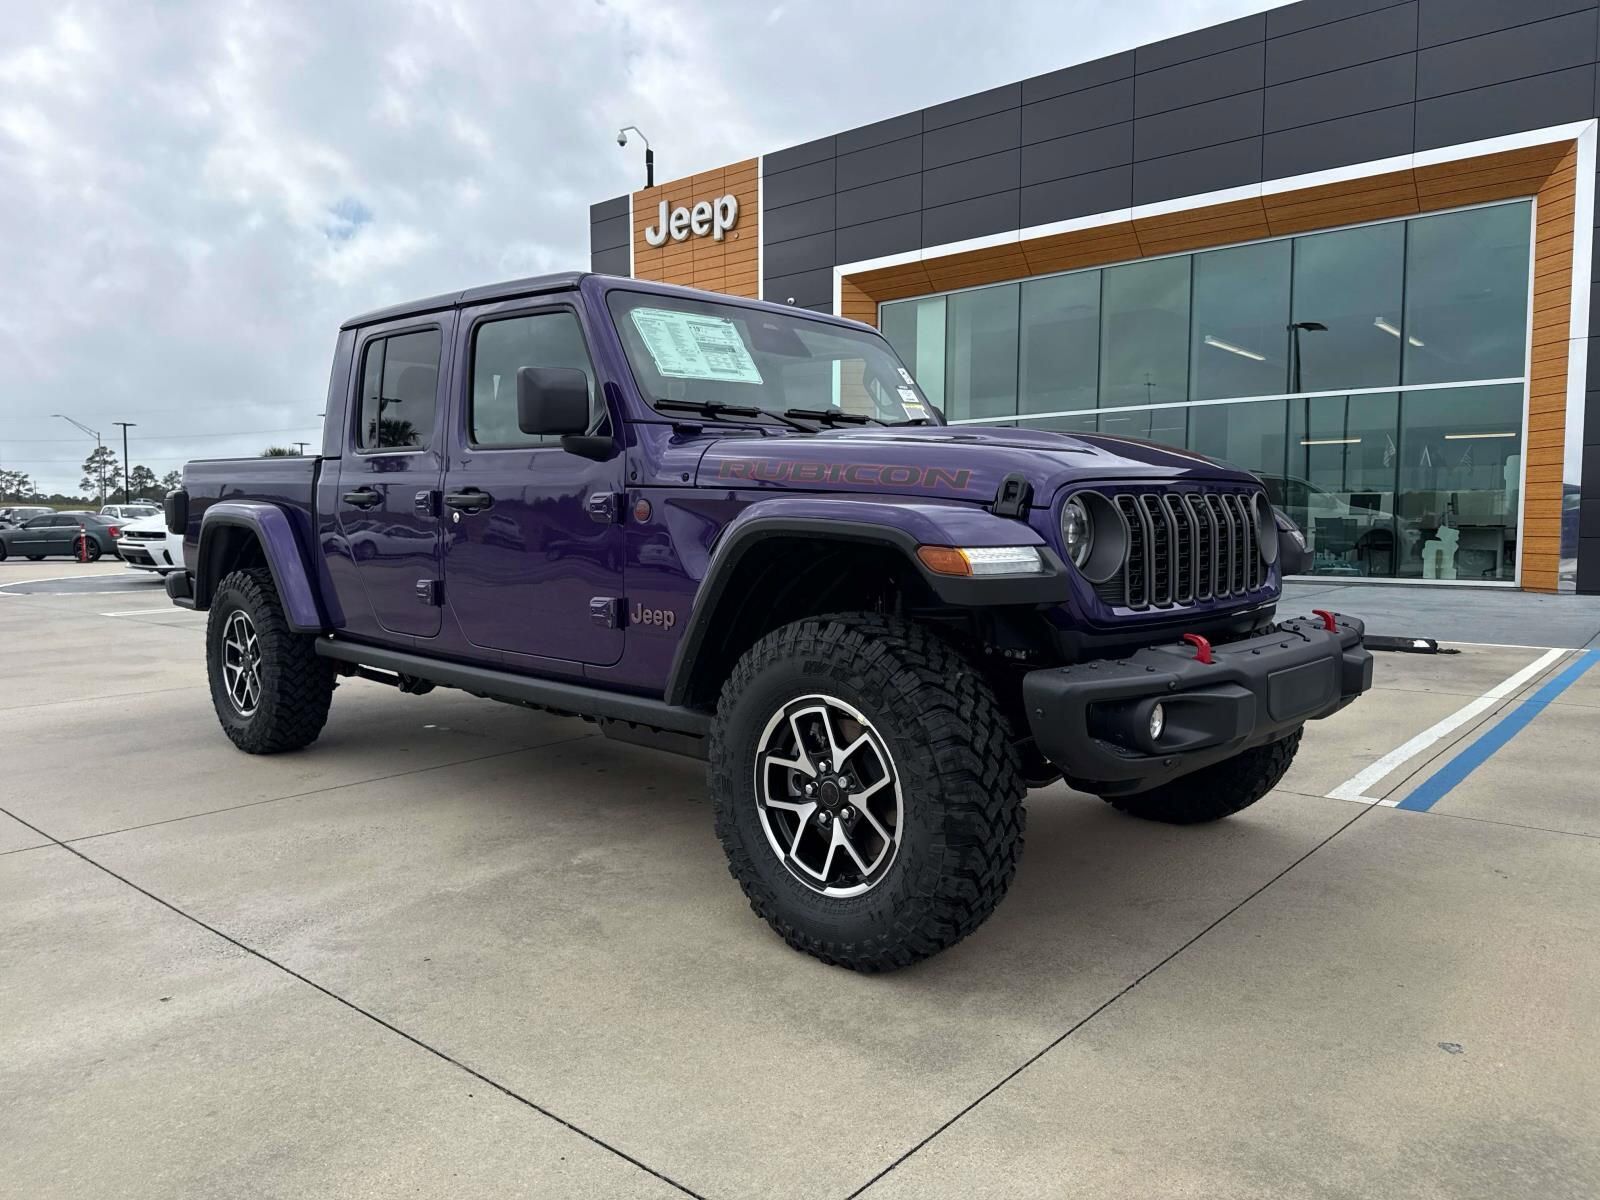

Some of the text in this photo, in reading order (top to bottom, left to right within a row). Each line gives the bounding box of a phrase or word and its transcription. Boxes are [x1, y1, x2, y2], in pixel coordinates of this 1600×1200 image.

[645, 194, 739, 248] Jeep
[719, 460, 973, 490] RUBICON
[631, 603, 675, 631] Jeep
